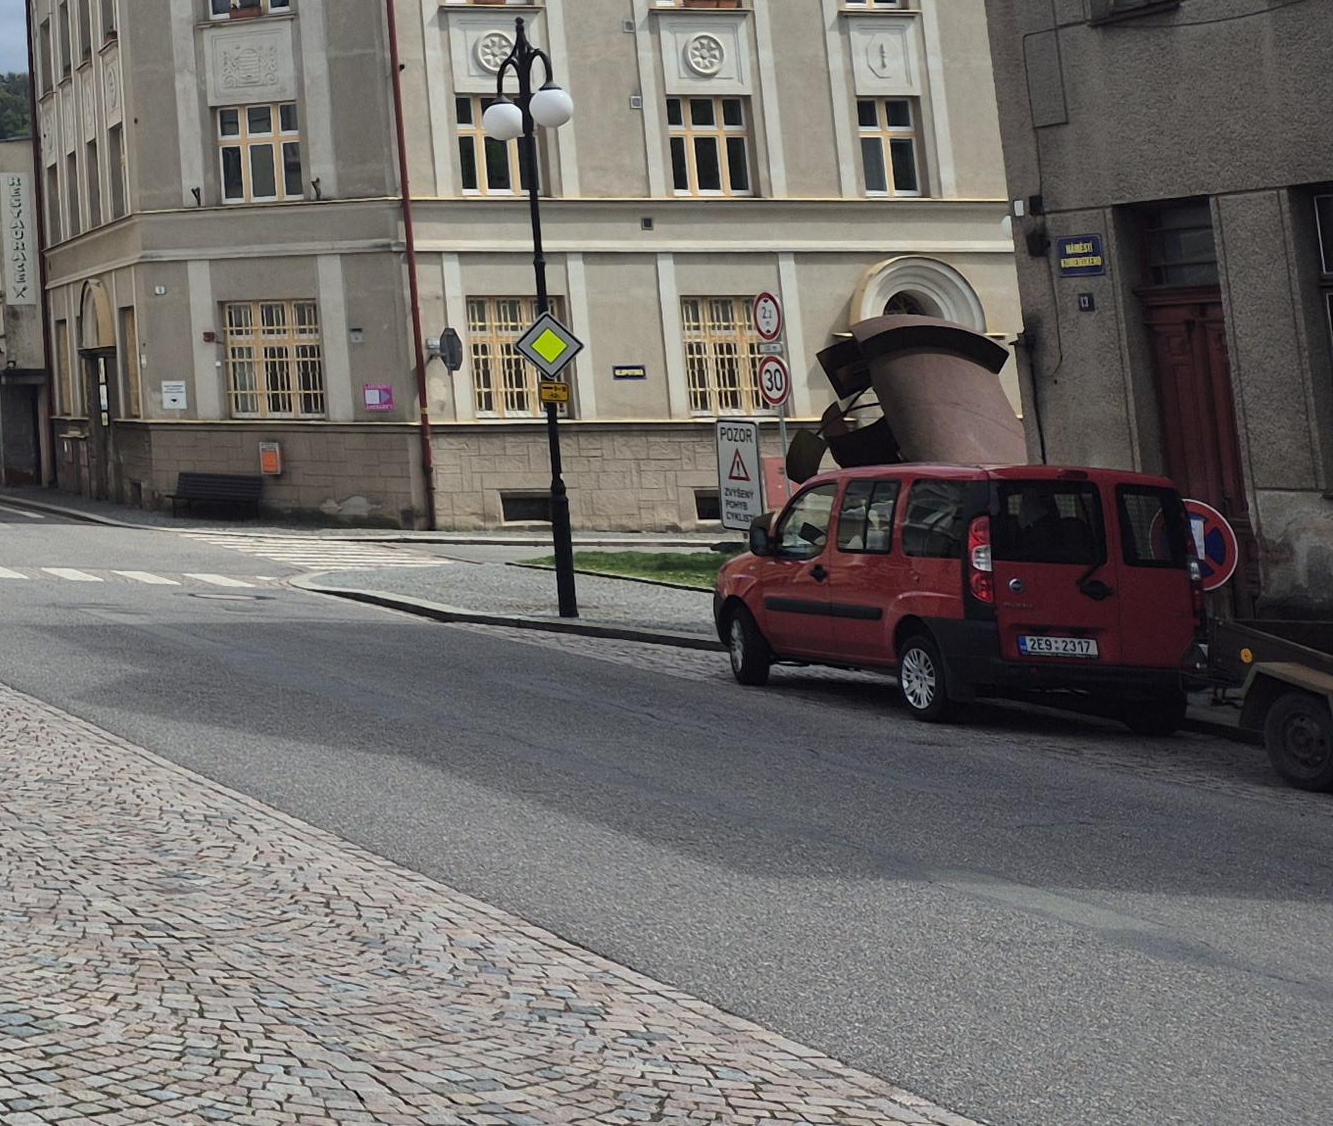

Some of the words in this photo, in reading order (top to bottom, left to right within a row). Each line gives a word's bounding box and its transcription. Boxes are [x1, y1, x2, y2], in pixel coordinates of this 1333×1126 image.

[7, 177, 27, 284] RESTAURACE
[764, 368, 784, 392] 30
[720, 427, 753, 443] POZOR
[725, 499, 748, 511] POHYB
[726, 511, 754, 523] CYKLIST
[1029, 638, 1053, 651] 2E9
[1062, 640, 1091, 653] 2317
